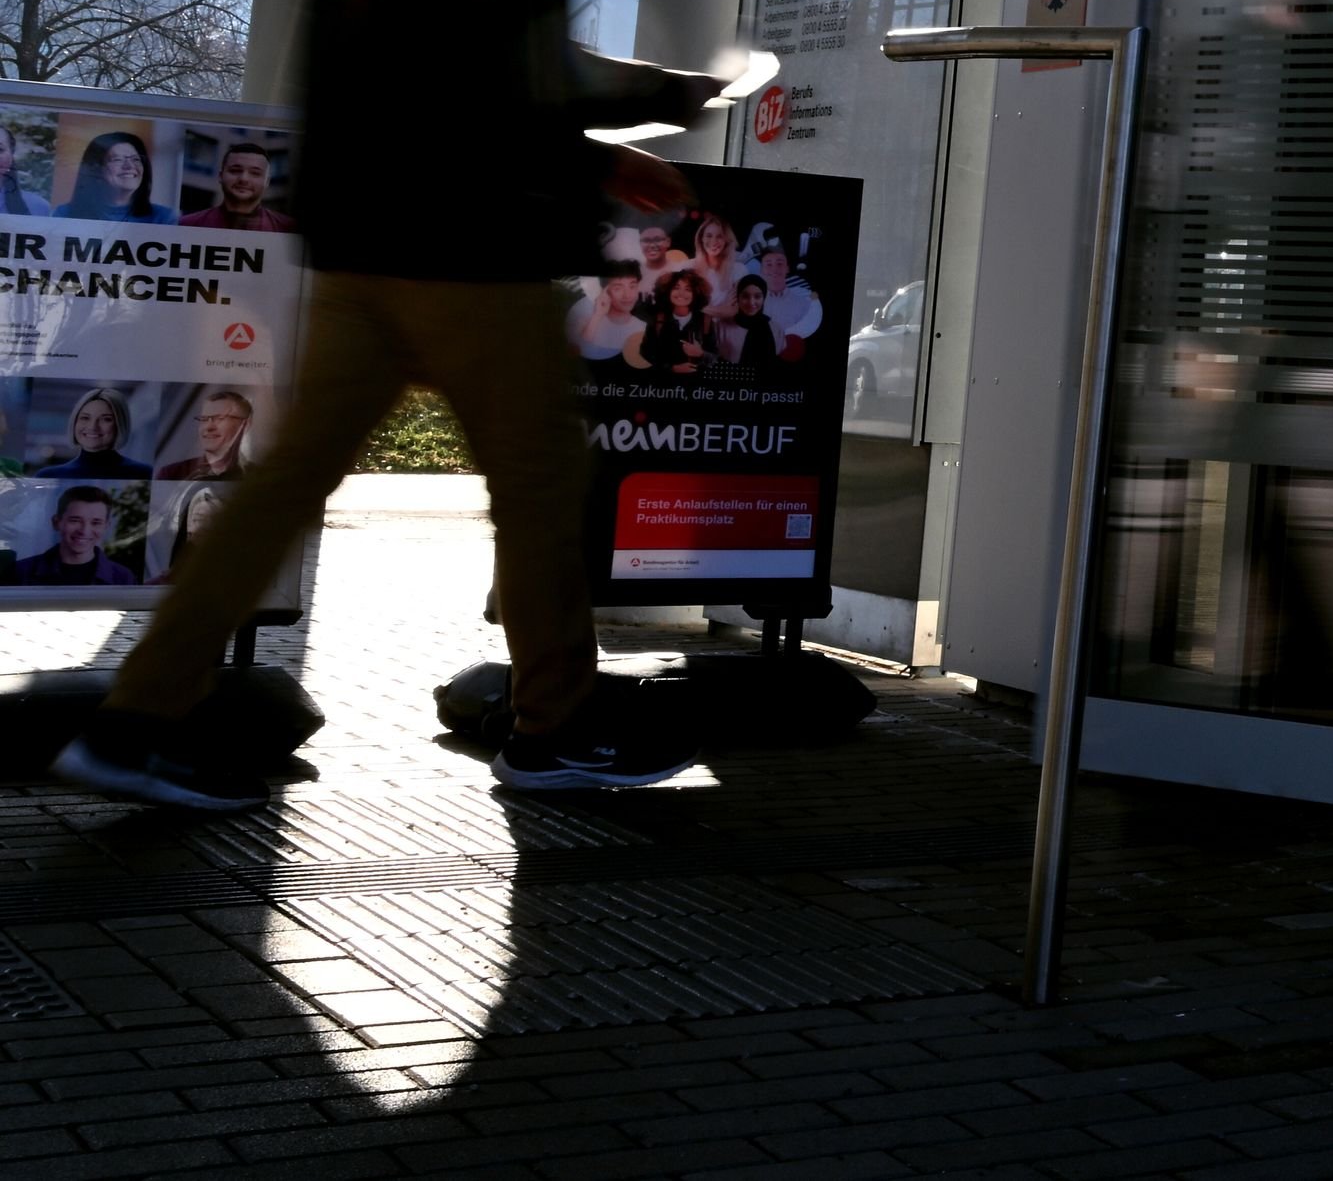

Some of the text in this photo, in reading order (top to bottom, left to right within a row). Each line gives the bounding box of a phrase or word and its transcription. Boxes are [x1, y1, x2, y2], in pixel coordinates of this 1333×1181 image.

[791, 84, 814, 100] Berufs
[757, 93, 785, 137] BiZ
[790, 104, 833, 120] Informations
[787, 126, 816, 140] Zentrum
[0, 232, 265, 274] IR MACHEN
[206, 359, 235, 369] bringt
[602, 383, 625, 398] die
[629, 384, 689, 402] Zukunft,
[692, 386, 714, 401] die
[718, 390, 735, 402] zu
[739, 388, 759, 403] Dir
[762, 389, 804, 406] passt!
[637, 498, 808, 512] Erste Anlaufstellen für einen
[636, 513, 734, 527] Praktikumsplatz
